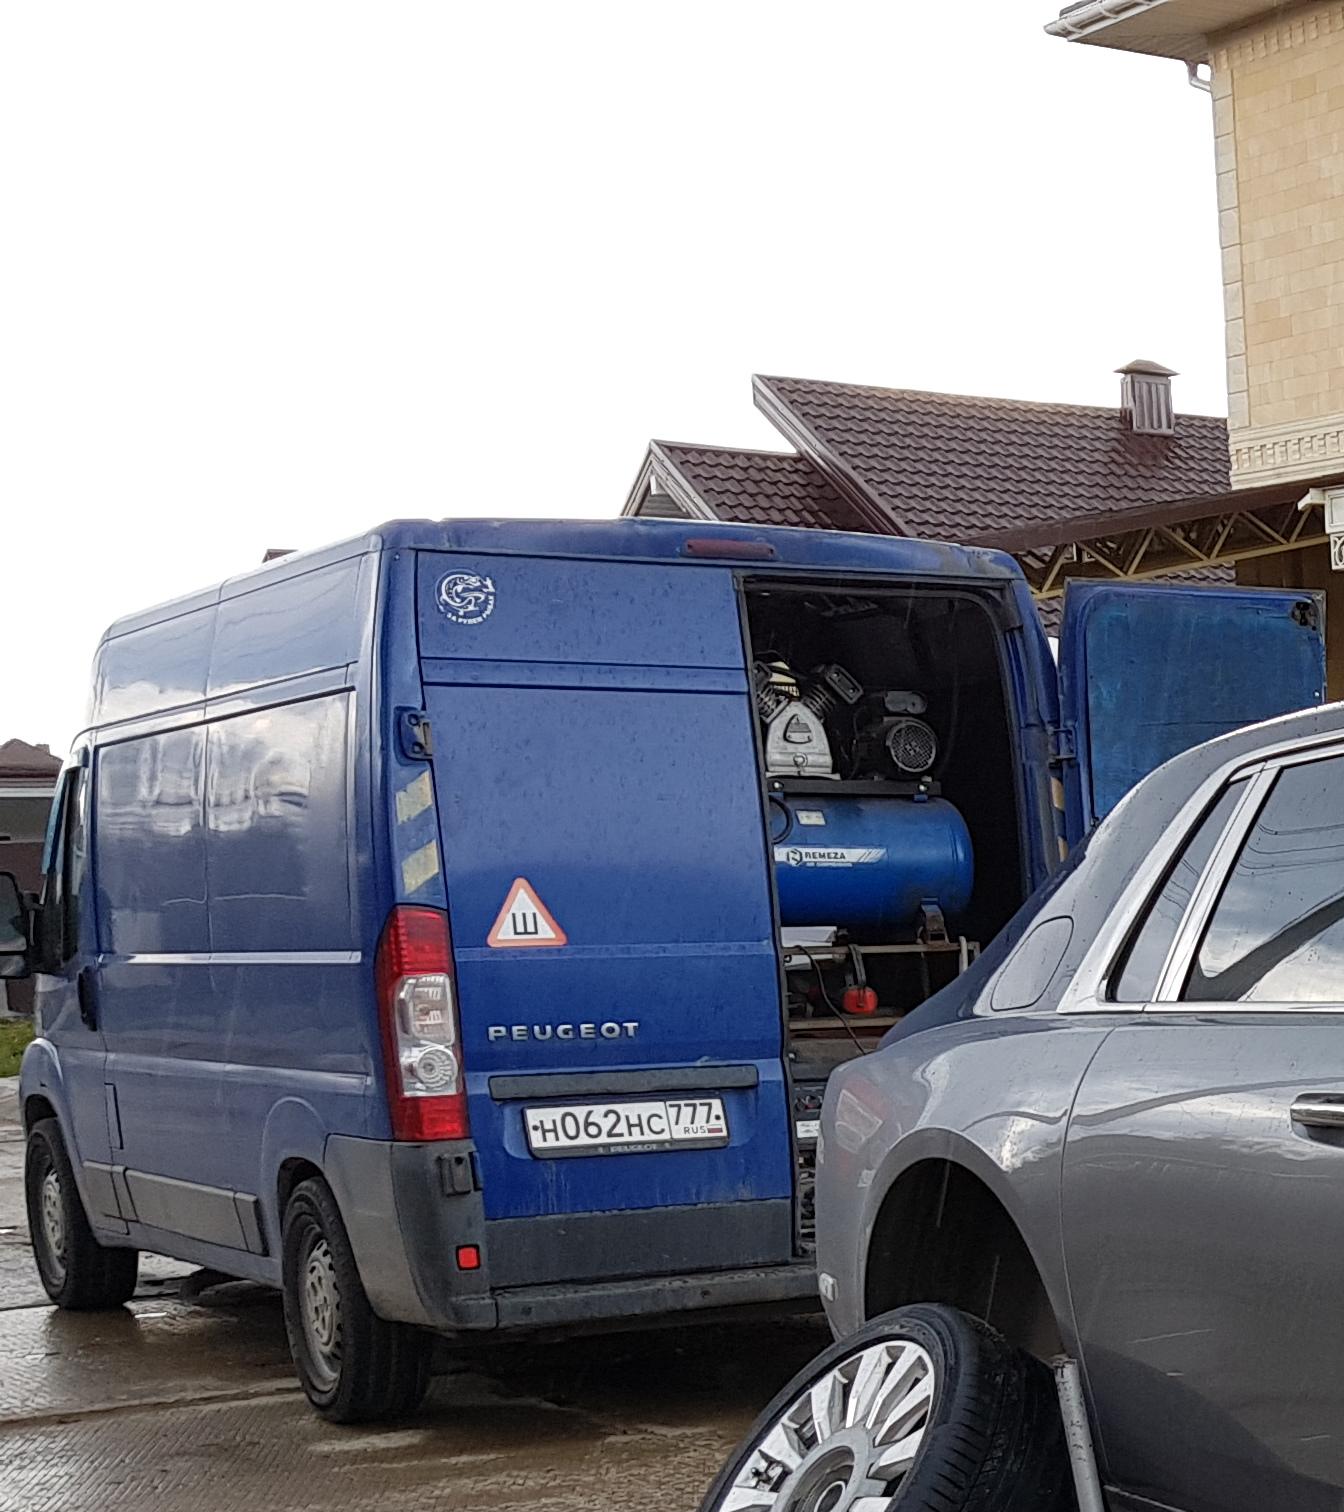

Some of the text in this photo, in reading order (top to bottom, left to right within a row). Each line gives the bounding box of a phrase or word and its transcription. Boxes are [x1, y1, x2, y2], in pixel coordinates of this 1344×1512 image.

[804, 851, 846, 860] REMEZA
[487, 1022, 640, 1042] PEUGEOT
[683, 1125, 706, 1135] RUS
